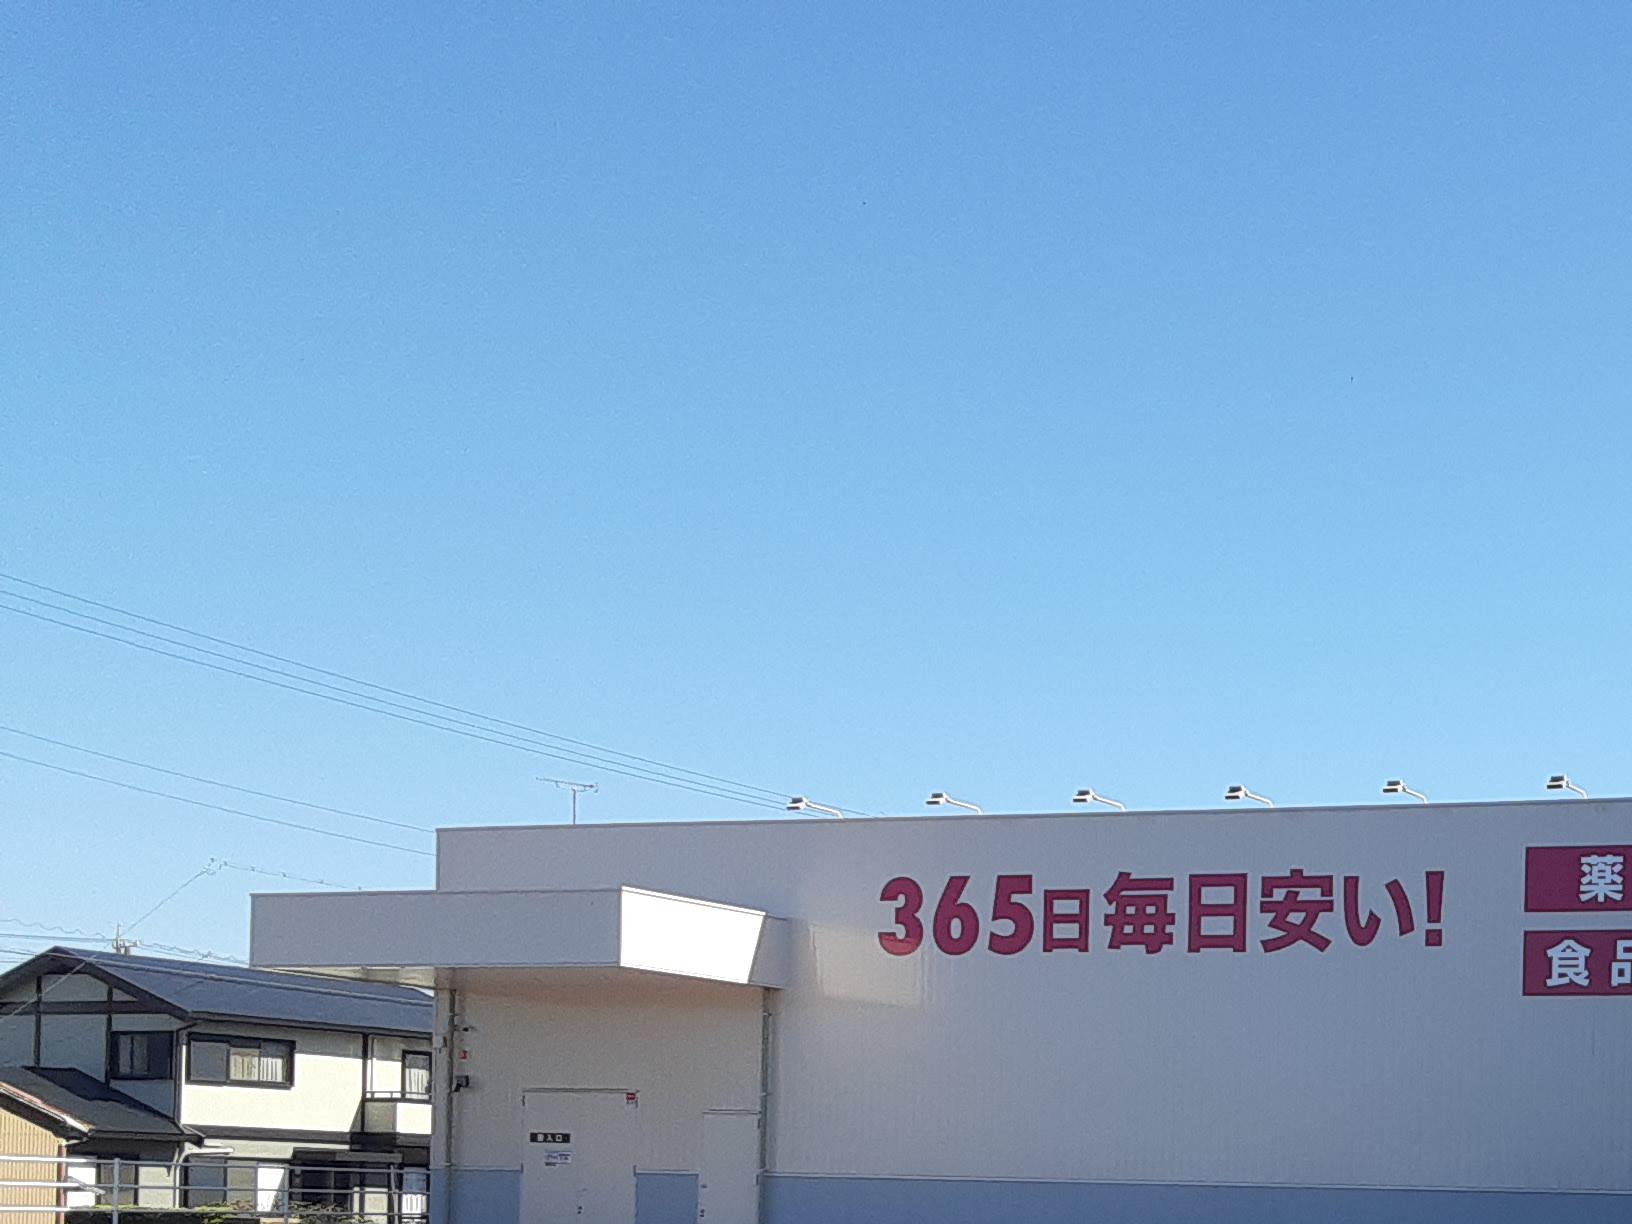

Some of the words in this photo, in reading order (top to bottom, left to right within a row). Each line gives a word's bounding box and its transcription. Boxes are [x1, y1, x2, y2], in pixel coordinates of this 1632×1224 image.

[878, 868, 1446, 956] 365日毎日安い!
[1578, 854, 1625, 903] 薬
